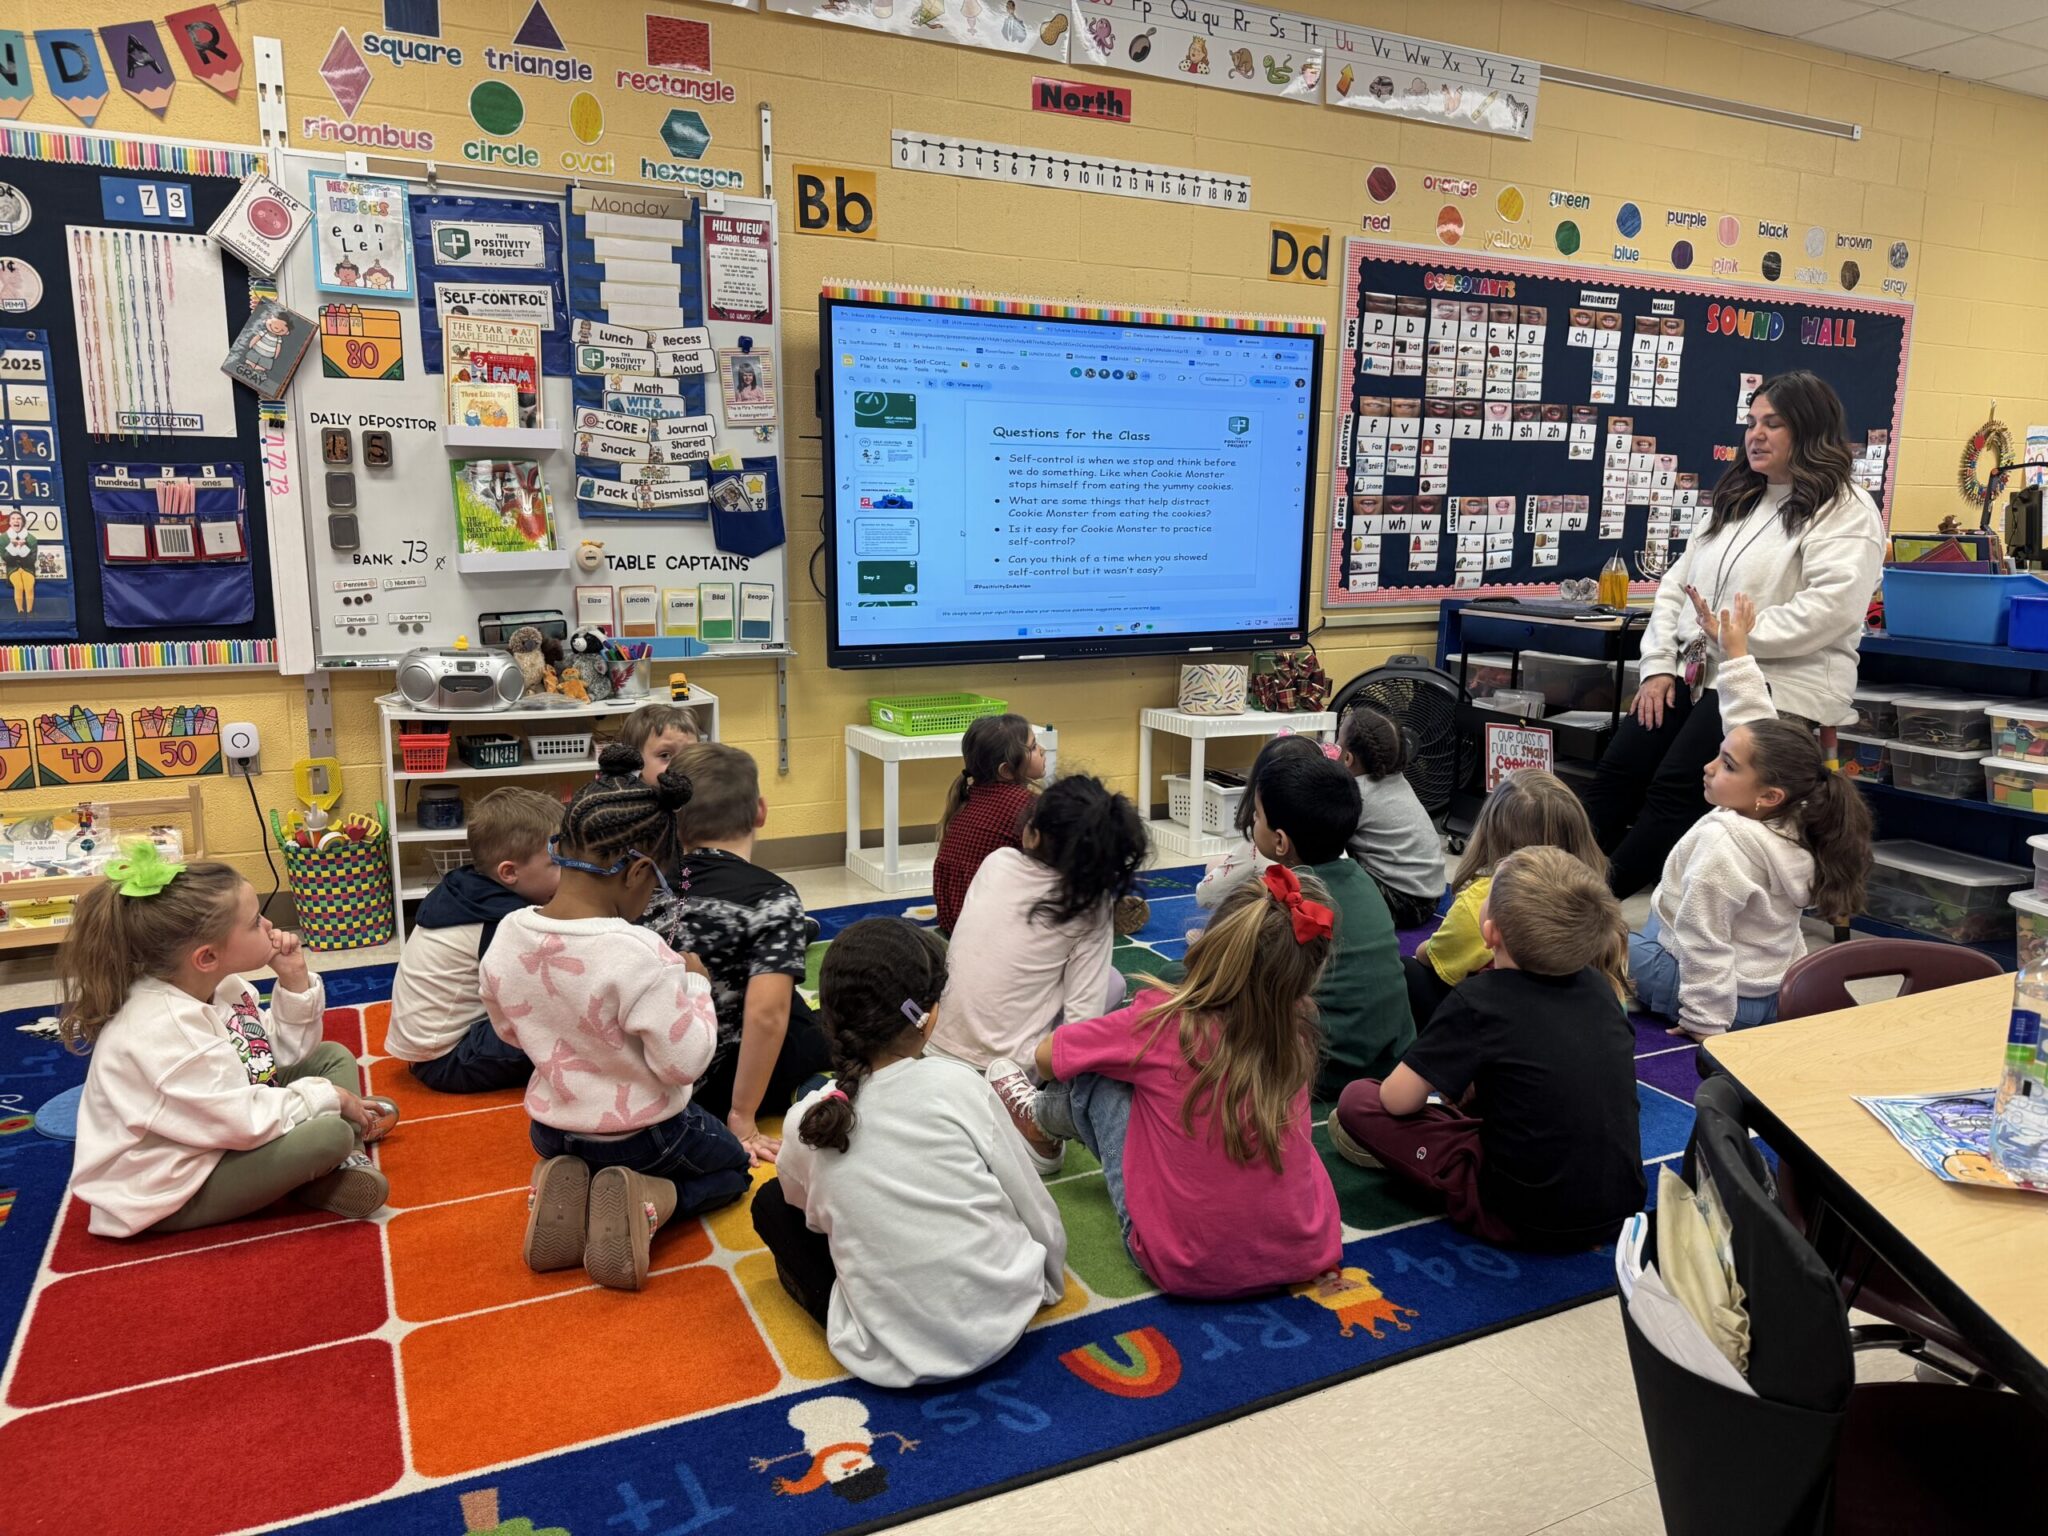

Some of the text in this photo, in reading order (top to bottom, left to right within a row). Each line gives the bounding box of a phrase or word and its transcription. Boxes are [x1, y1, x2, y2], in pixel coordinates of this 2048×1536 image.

[1170, 0, 1220, 39] Qu qu
[1234, 8, 1250, 33] Rr
[1270, 16, 1285, 39] Ss
[1301, 22, 1318, 44] Tt
[1336, 30, 1354, 52] Uu
[364, 34, 461, 65] square
[1372, 36, 1390, 59] Vv
[1404, 43, 1429, 67] Ww
[485, 48, 592, 81] triangle
[1442, 51, 1460, 73] Xx
[1476, 57, 1494, 86] Yy
[1511, 64, 1525, 84] Zz
[617, 70, 734, 102] rectangle
[1041, 83, 1123, 117] North
[304, 116, 433, 151] rhombus
[464, 140, 539, 166] circle
[561, 150, 614, 173] oval
[642, 158, 743, 189] hexagon
[1423, 172, 1478, 198] orange
[143, 190, 182, 208] 7 3
[330, 197, 390, 216] HEROES
[591, 196, 669, 218] Monday
[798, 174, 872, 233] Bb
[1549, 190, 1590, 210] green
[713, 220, 762, 235] HILL VIEW
[1362, 215, 1391, 232] red
[1666, 210, 1707, 230] purple
[1758, 220, 1788, 240] black
[475, 239, 530, 248] POSITIVITY
[717, 233, 759, 245] SCHOOL SONG
[1484, 230, 1532, 250] yellow
[1836, 232, 1872, 252] brown
[483, 249, 524, 258] PROJECT
[1271, 230, 1329, 280] Dd
[1614, 244, 1640, 263] blue
[1712, 256, 1739, 276] pink
[1424, 272, 1516, 298] CONSONANTS
[1882, 276, 1908, 296] gray
[1580, 294, 1617, 305] AFFRICATES
[1652, 302, 1673, 311] NASALS
[452, 322, 472, 331] THE
[476, 325, 502, 333] YEAR
[1345, 318, 1356, 349] STOPS
[1707, 304, 1856, 347] SOUND WALL
[453, 332, 533, 345] MAPLE HILL FARM
[600, 330, 633, 345] Lunch
[663, 335, 701, 346] Recess
[1575, 330, 1587, 344] ch
[346, 340, 379, 369] 80
[672, 352, 698, 362] Read
[1500, 349, 1512, 357] cap
[1, 357, 42, 370] 2025
[673, 364, 703, 375] Aloud
[236, 365, 267, 387] GRAY
[493, 367, 531, 383] FARM
[634, 383, 663, 394] Math
[627, 396, 662, 408] WIT &
[121, 415, 198, 428] CLIP COLLECTION
[311, 412, 436, 431] DAILY DEPOSITOR
[626, 408, 680, 418] WISDOM
[606, 420, 638, 434] CORE
[667, 422, 708, 435] Journal
[993, 427, 1150, 441] Questions for the Class
[1492, 425, 1503, 436] th
[1520, 425, 1533, 438] sh
[1547, 426, 1559, 438] zh
[672, 439, 706, 449] Shared
[1340, 414, 1351, 465] FRICATIVES
[1404, 444, 1416, 452] van
[37, 443, 47, 457] 6
[601, 443, 636, 457] Snack
[671, 450, 709, 460] Reading
[1009, 454, 1074, 464] Self-control
[1077, 455, 1085, 464] is
[1089, 456, 1114, 465] when
[1133, 457, 1154, 467] stop
[1157, 458, 1174, 466] and
[1177, 458, 1201, 466] think
[1205, 458, 1236, 467] before
[1027, 467, 1039, 476] do
[1042, 467, 1097, 478] something.
[1100, 469, 1120, 477] Like
[1124, 469, 1148, 478] when
[1151, 470, 1182, 478] Cookie
[1186, 470, 1224, 478] Monster
[33, 483, 50, 496] 13
[97, 478, 139, 488] hundreds
[202, 479, 222, 487] ones
[1008, 480, 1233, 492] stops himself from eating the yummy cookies.
[597, 485, 628, 499] Pack
[654, 487, 704, 500] Dismissal
[26, 512, 58, 531] 20
[1449, 499, 1457, 532] LIQUIDS
[1568, 517, 1581, 530] qu
[353, 554, 393, 565] BANK
[605, 555, 750, 571] TABLE CAPTAINS
[627, 596, 649, 604] Lincoln
[1498, 730, 1543, 747] OUR CLASS IS
[160, 740, 197, 767] 50
[1491, 742, 1548, 760] FULL OF SMART
[62, 747, 102, 774] 40
[605, 1460, 735, 1532] Tt
